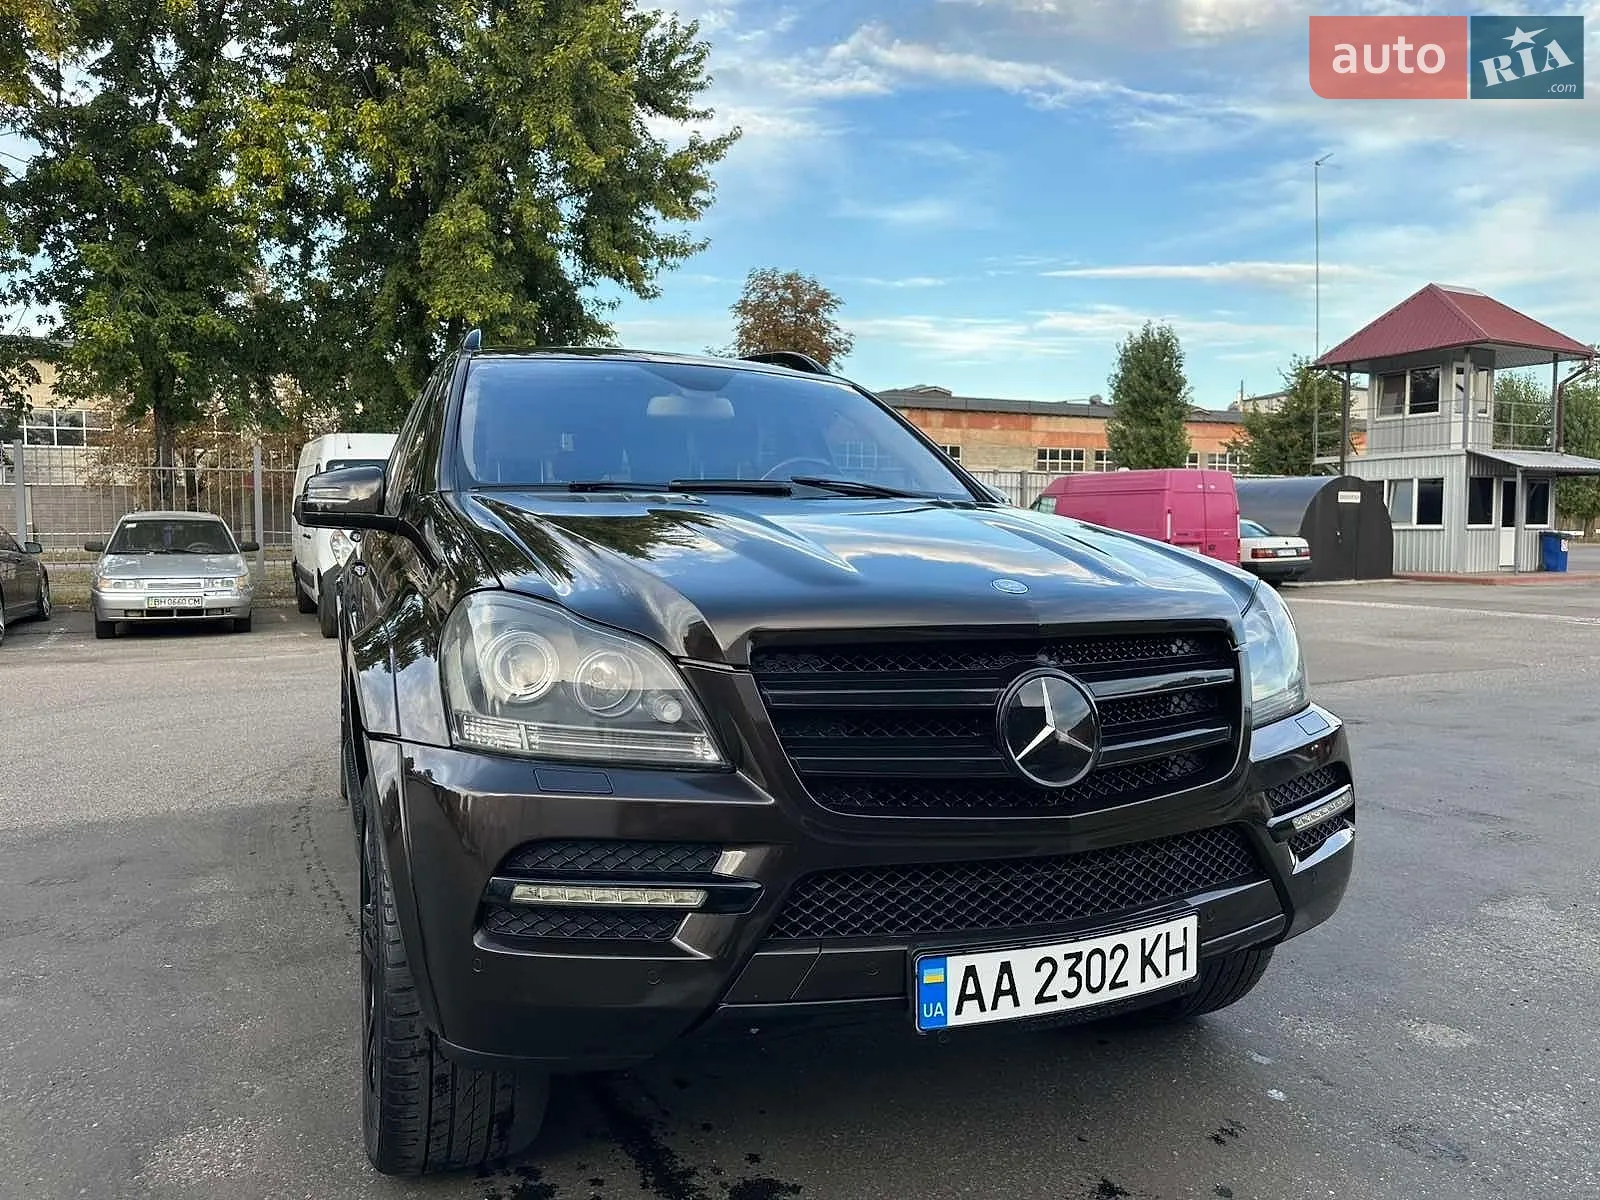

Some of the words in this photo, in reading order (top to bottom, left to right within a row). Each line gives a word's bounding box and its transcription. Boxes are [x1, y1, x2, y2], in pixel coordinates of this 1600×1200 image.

[188, 598, 201, 606] CM
[954, 960, 1021, 1016] AA
[1034, 943, 1129, 1005] 2302
[1139, 926, 1189, 984] KH
[923, 1001, 944, 1018] UA
